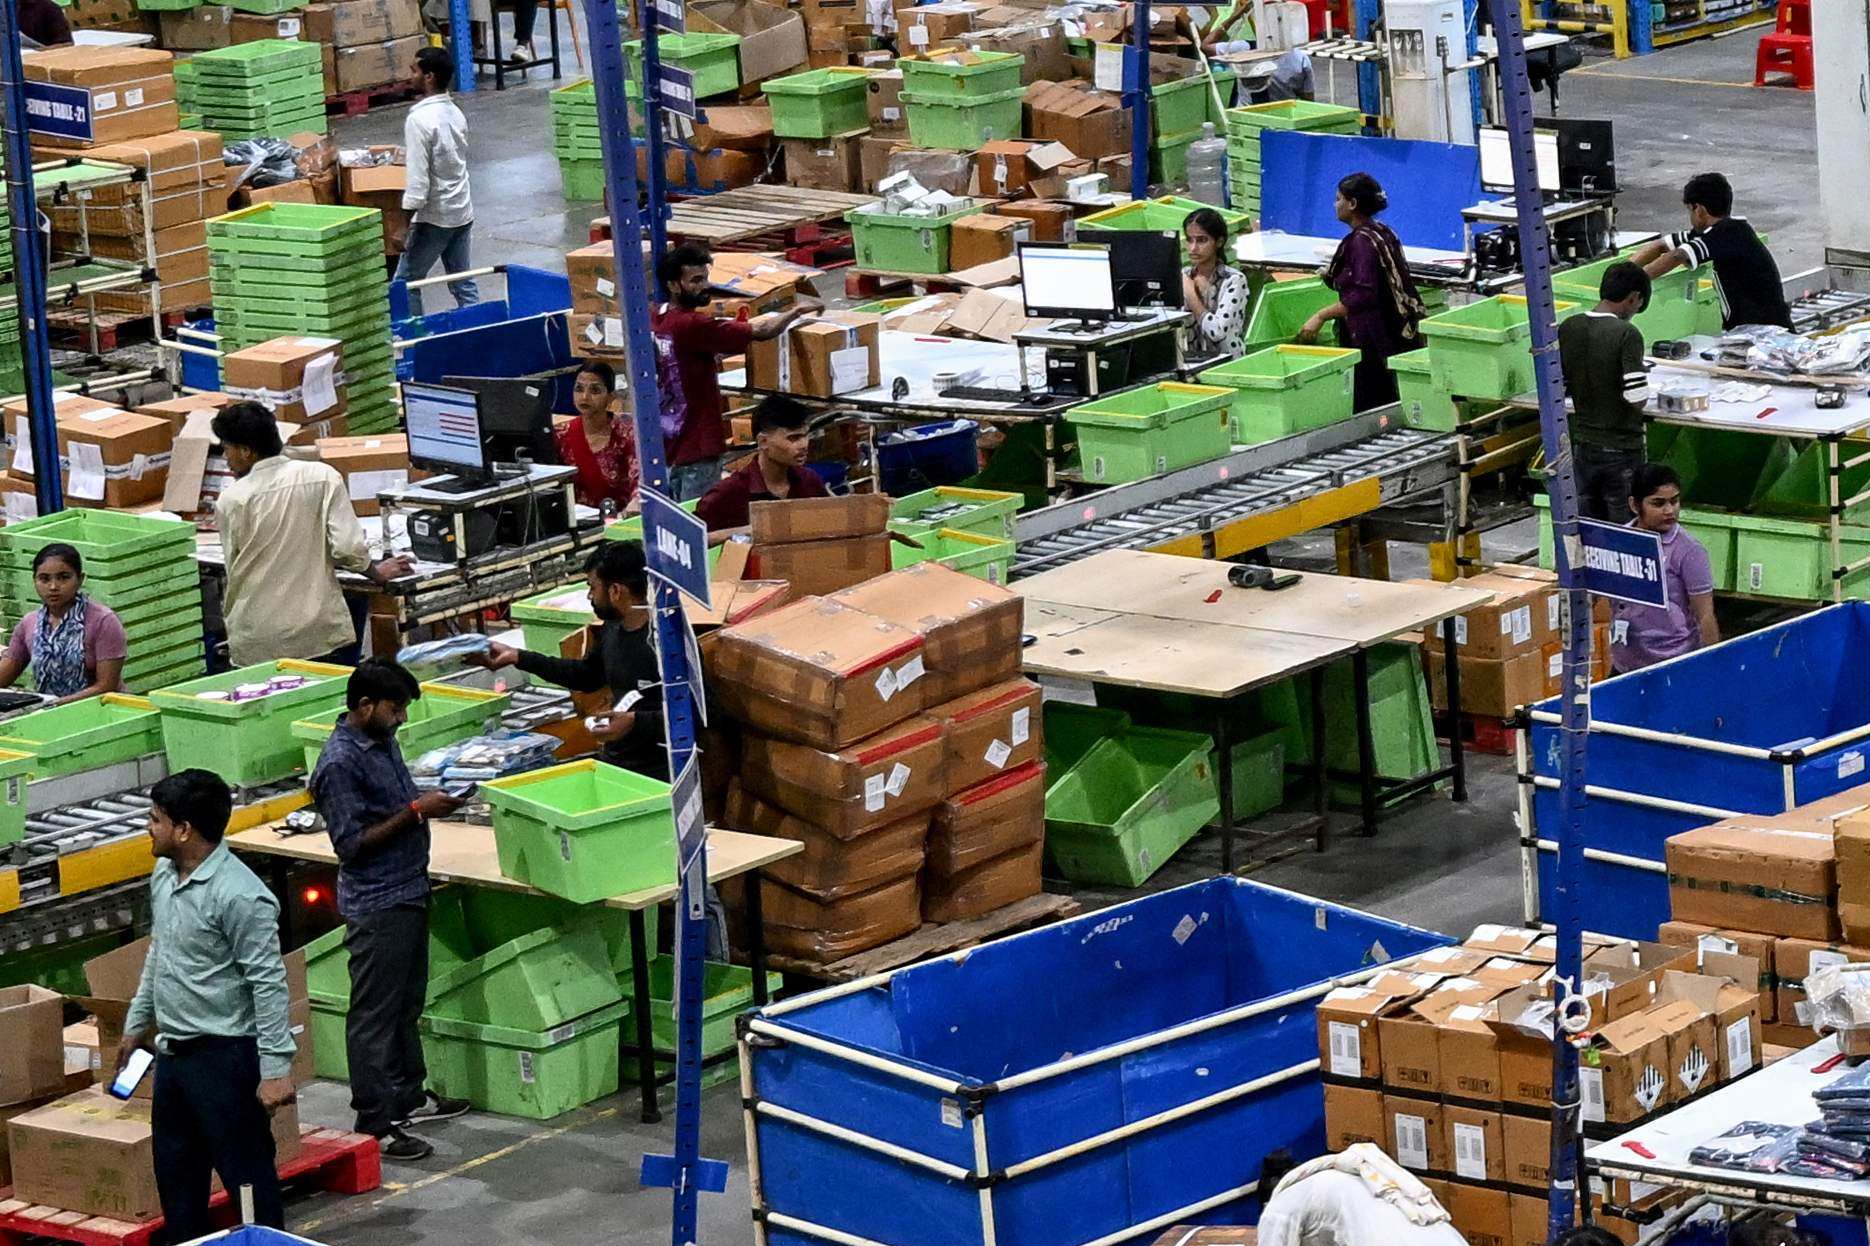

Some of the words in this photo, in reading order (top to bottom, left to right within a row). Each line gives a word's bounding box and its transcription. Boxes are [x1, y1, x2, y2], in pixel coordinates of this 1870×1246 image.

[52, 102, 74, 121] TABLE
[1585, 545, 1621, 575] ECEIVING
[1620, 552, 1645, 580] TABLE
[1644, 557, 1658, 582] -31
